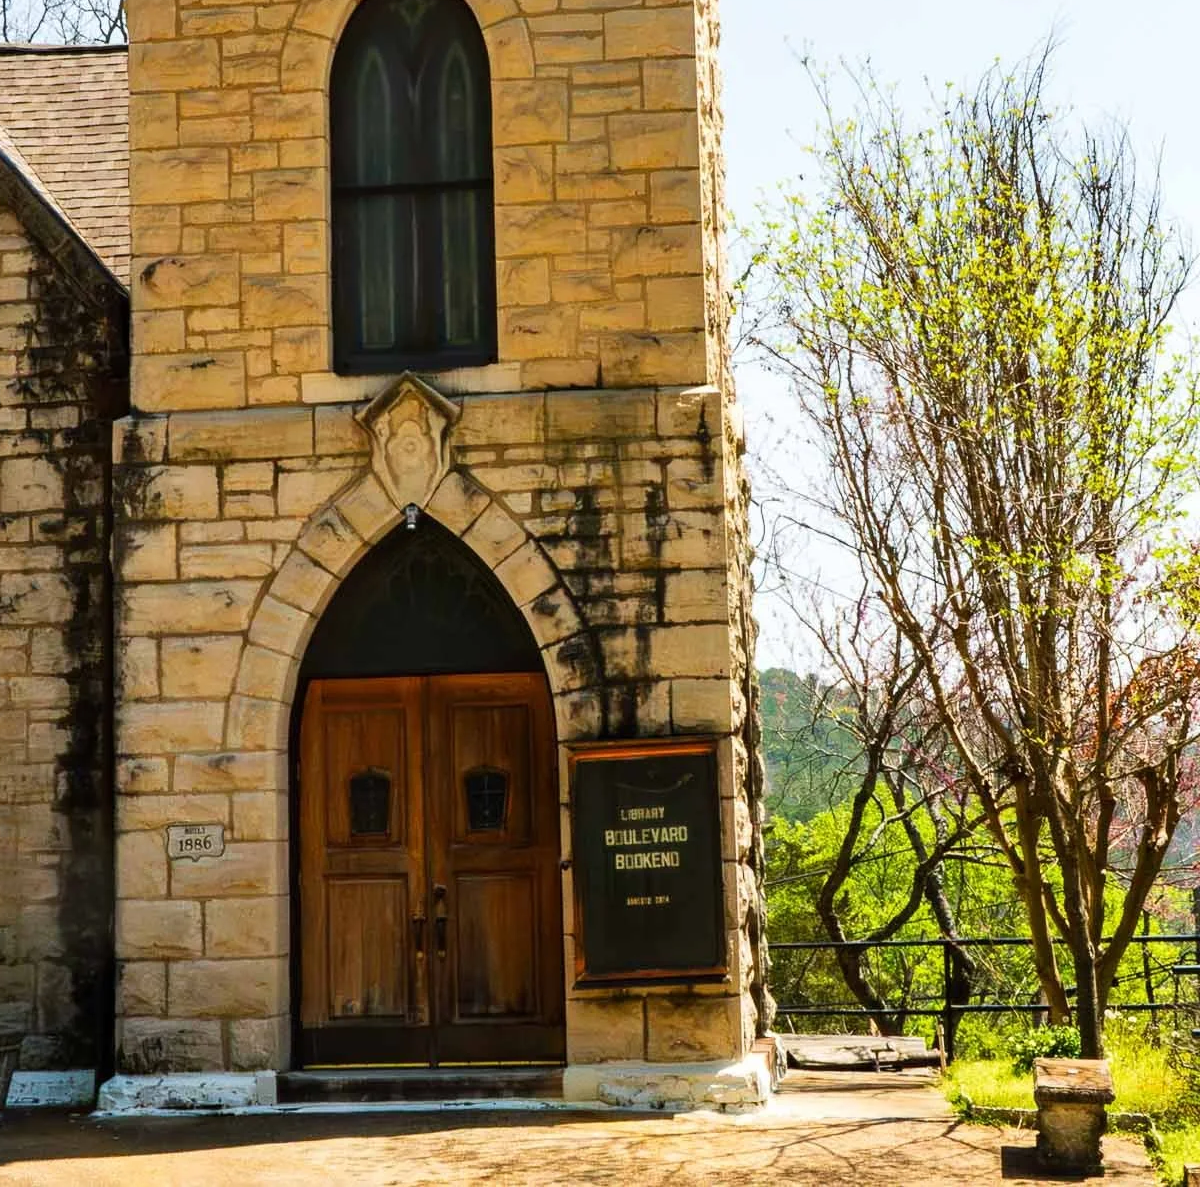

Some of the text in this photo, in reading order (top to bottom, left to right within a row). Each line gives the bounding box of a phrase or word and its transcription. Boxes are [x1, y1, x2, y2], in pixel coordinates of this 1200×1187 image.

[620, 807, 664, 821] LIBRARY
[179, 835, 212, 852] 1886
[605, 826, 688, 846] BOULEVARD
[615, 851, 680, 870] BOOKEND
